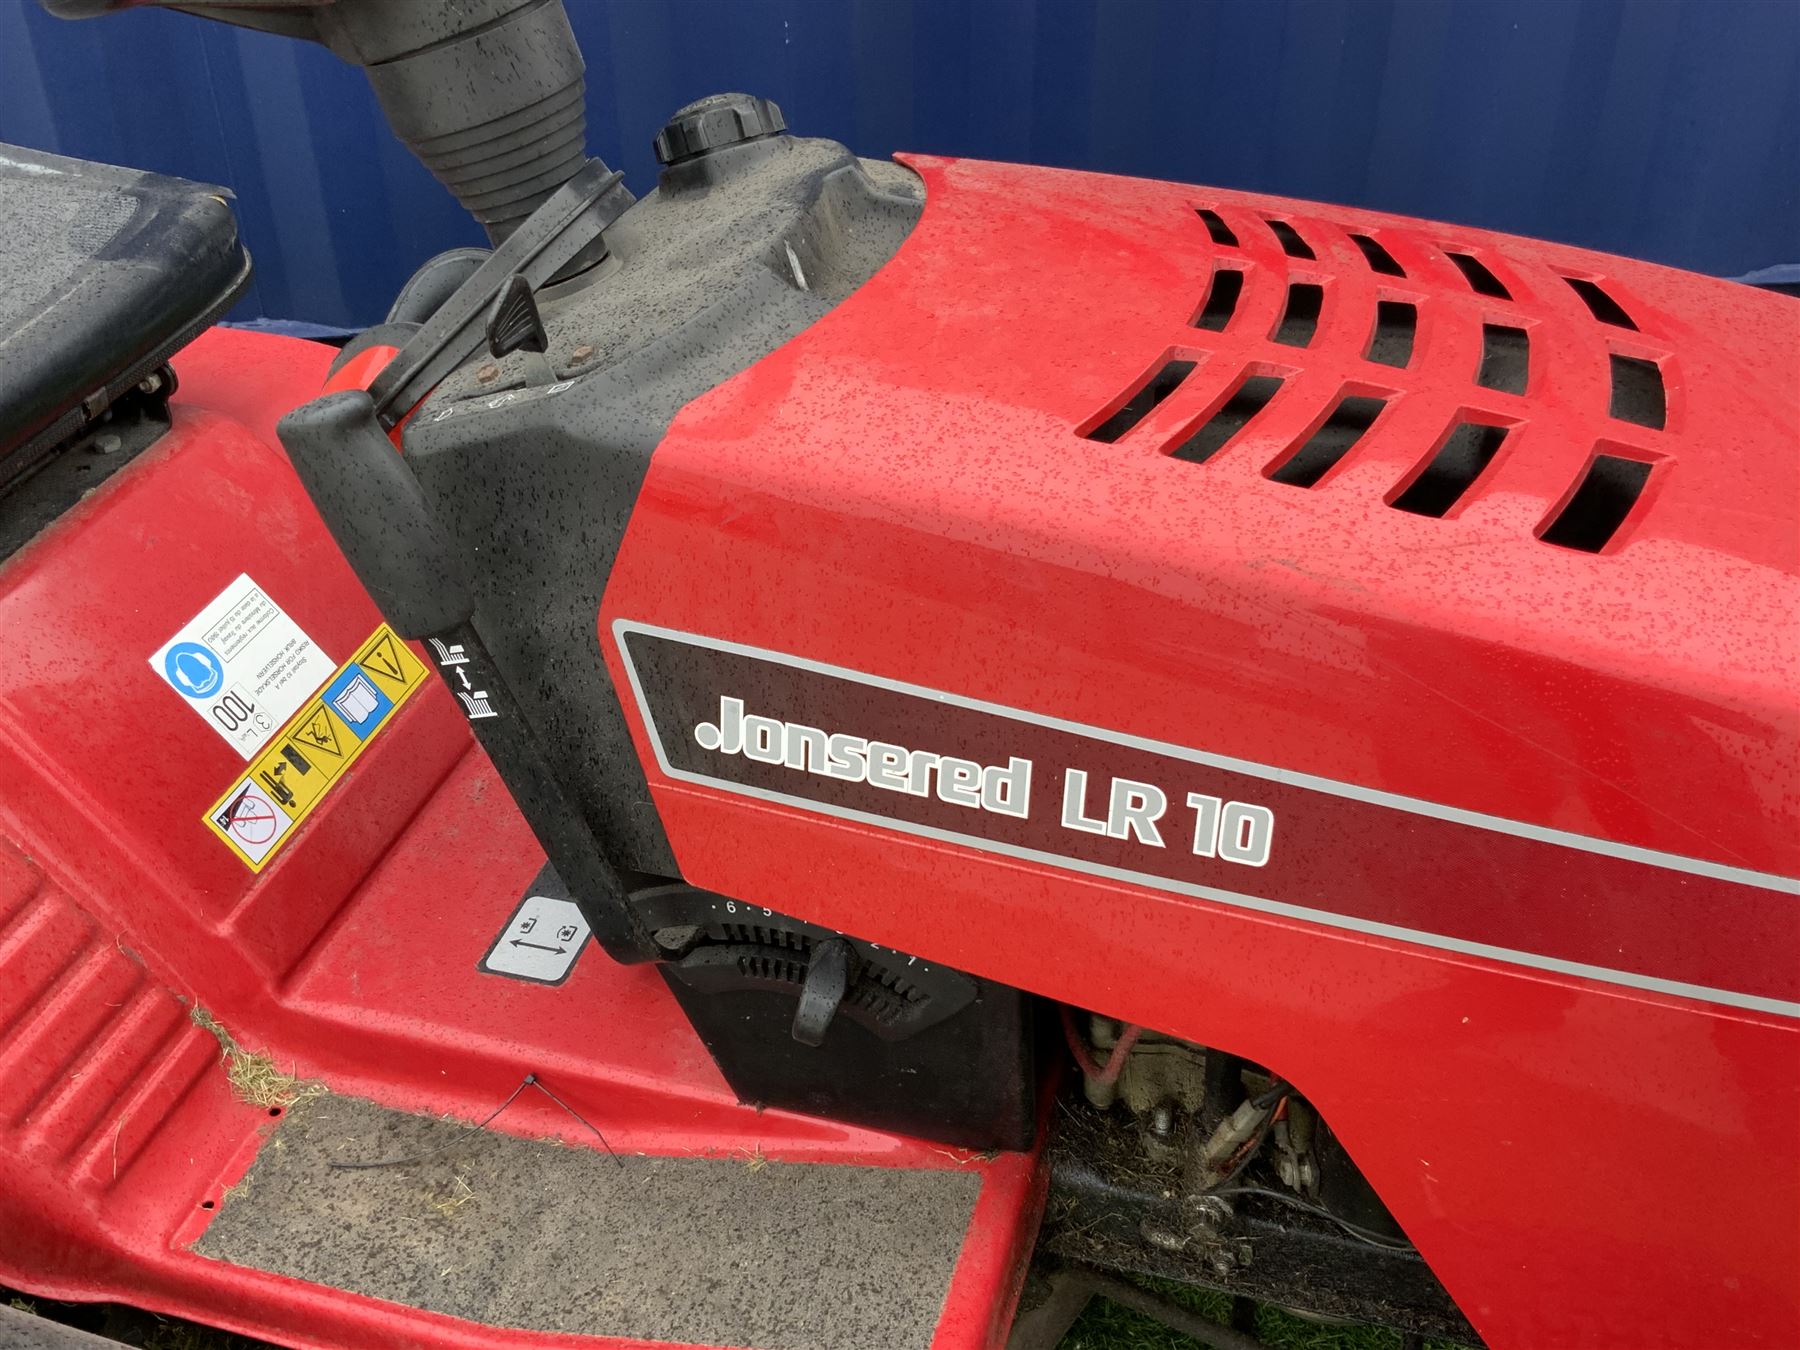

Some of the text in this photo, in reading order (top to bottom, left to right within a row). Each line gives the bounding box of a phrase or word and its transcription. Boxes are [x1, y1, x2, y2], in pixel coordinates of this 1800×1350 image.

[240, 600, 251, 611] date
[247, 623, 256, 633] aux
[212, 690, 255, 731] 100
[255, 714, 270, 730] 3
[694, 695, 1275, 867] Jonsered LR 10
[726, 900, 737, 914] 6
